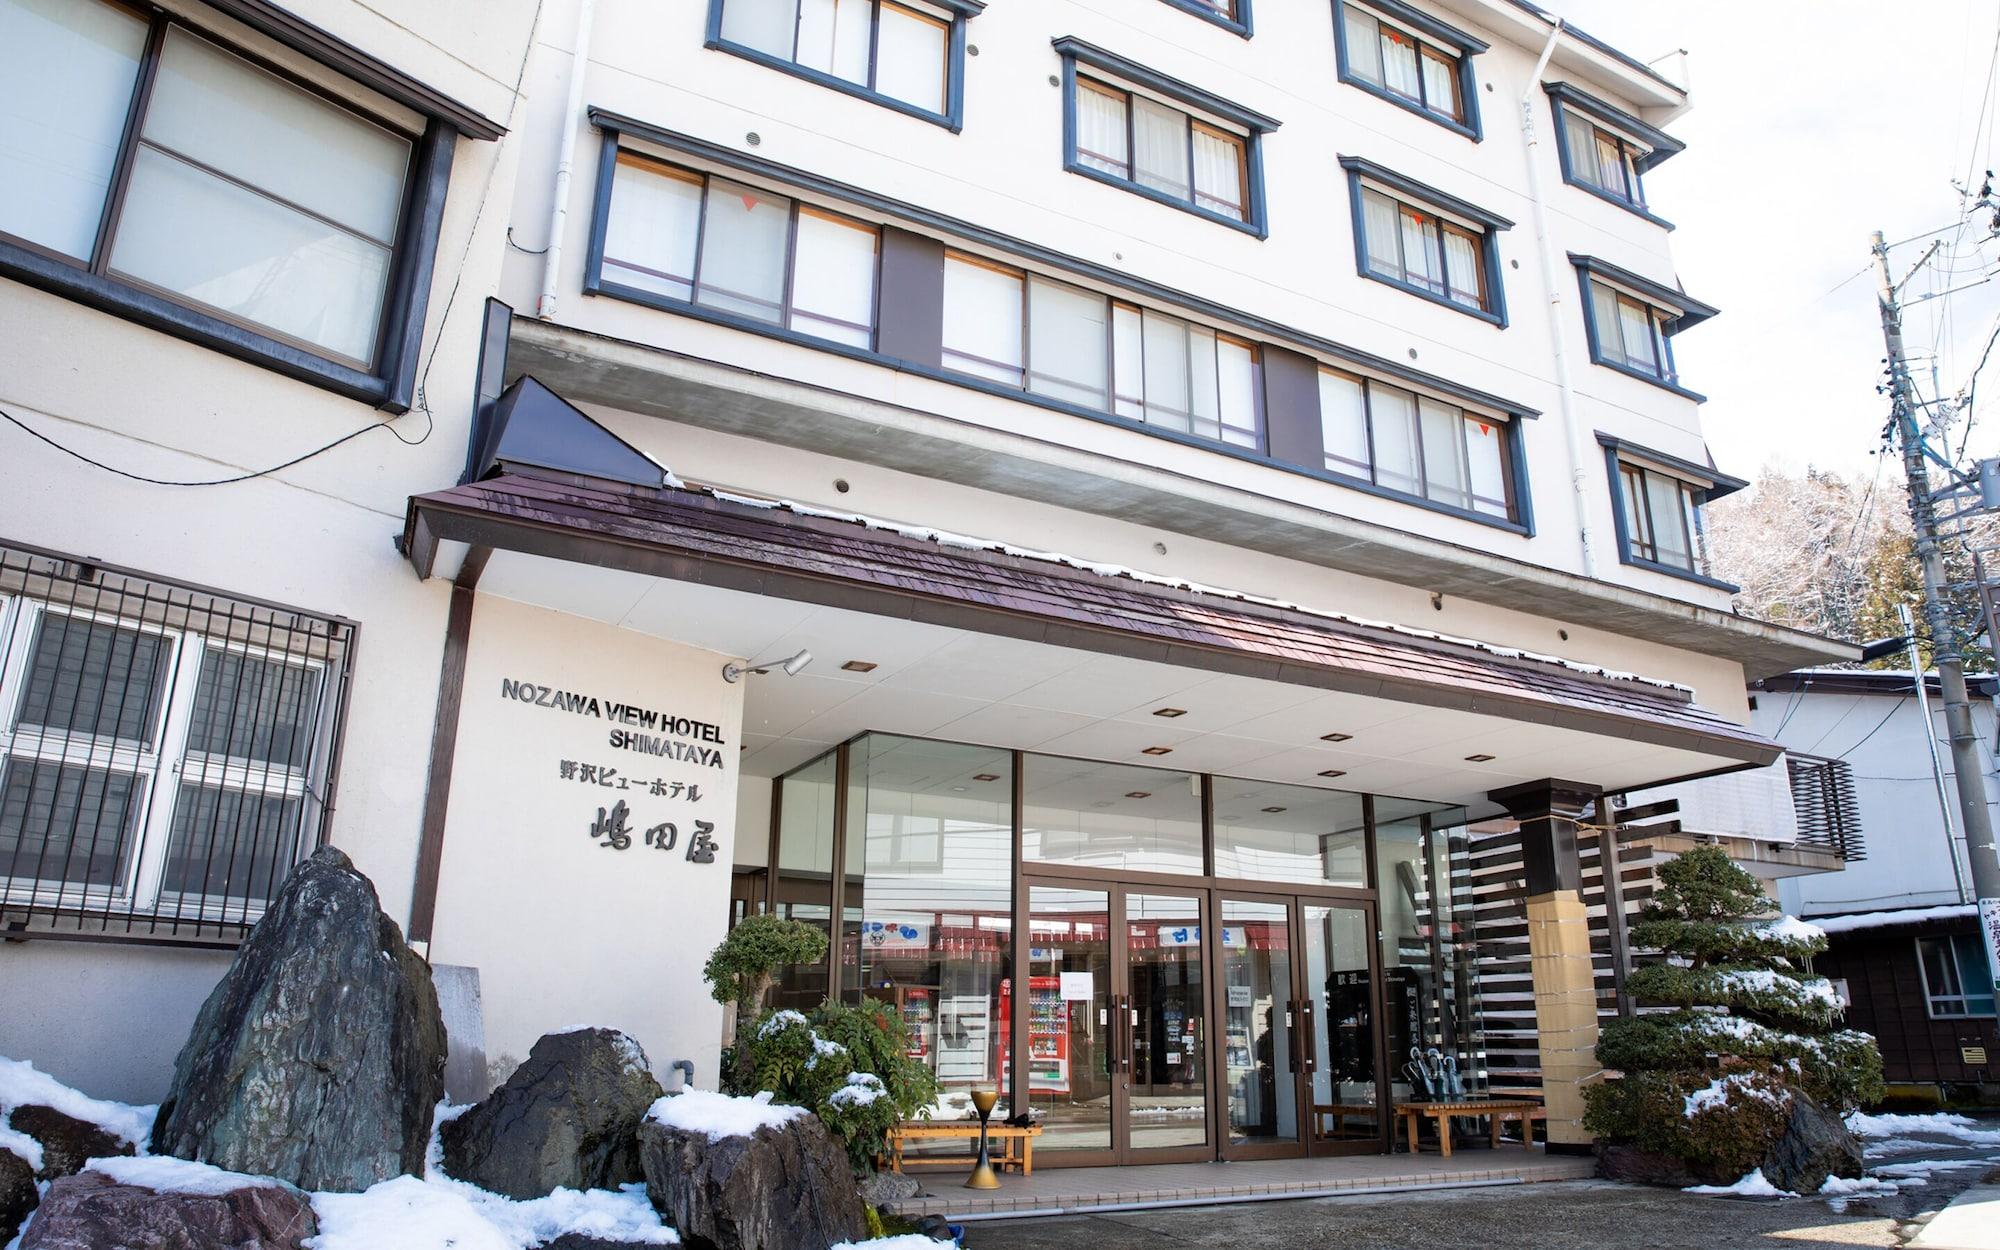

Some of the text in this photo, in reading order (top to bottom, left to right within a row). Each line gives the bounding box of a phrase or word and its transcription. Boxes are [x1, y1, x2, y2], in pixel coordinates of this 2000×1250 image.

[502, 678, 725, 744] NOZAWA VIEW HOTEL
[609, 729, 724, 769] SHIMATAYA
[560, 759, 703, 802] 野沢ビューホテル
